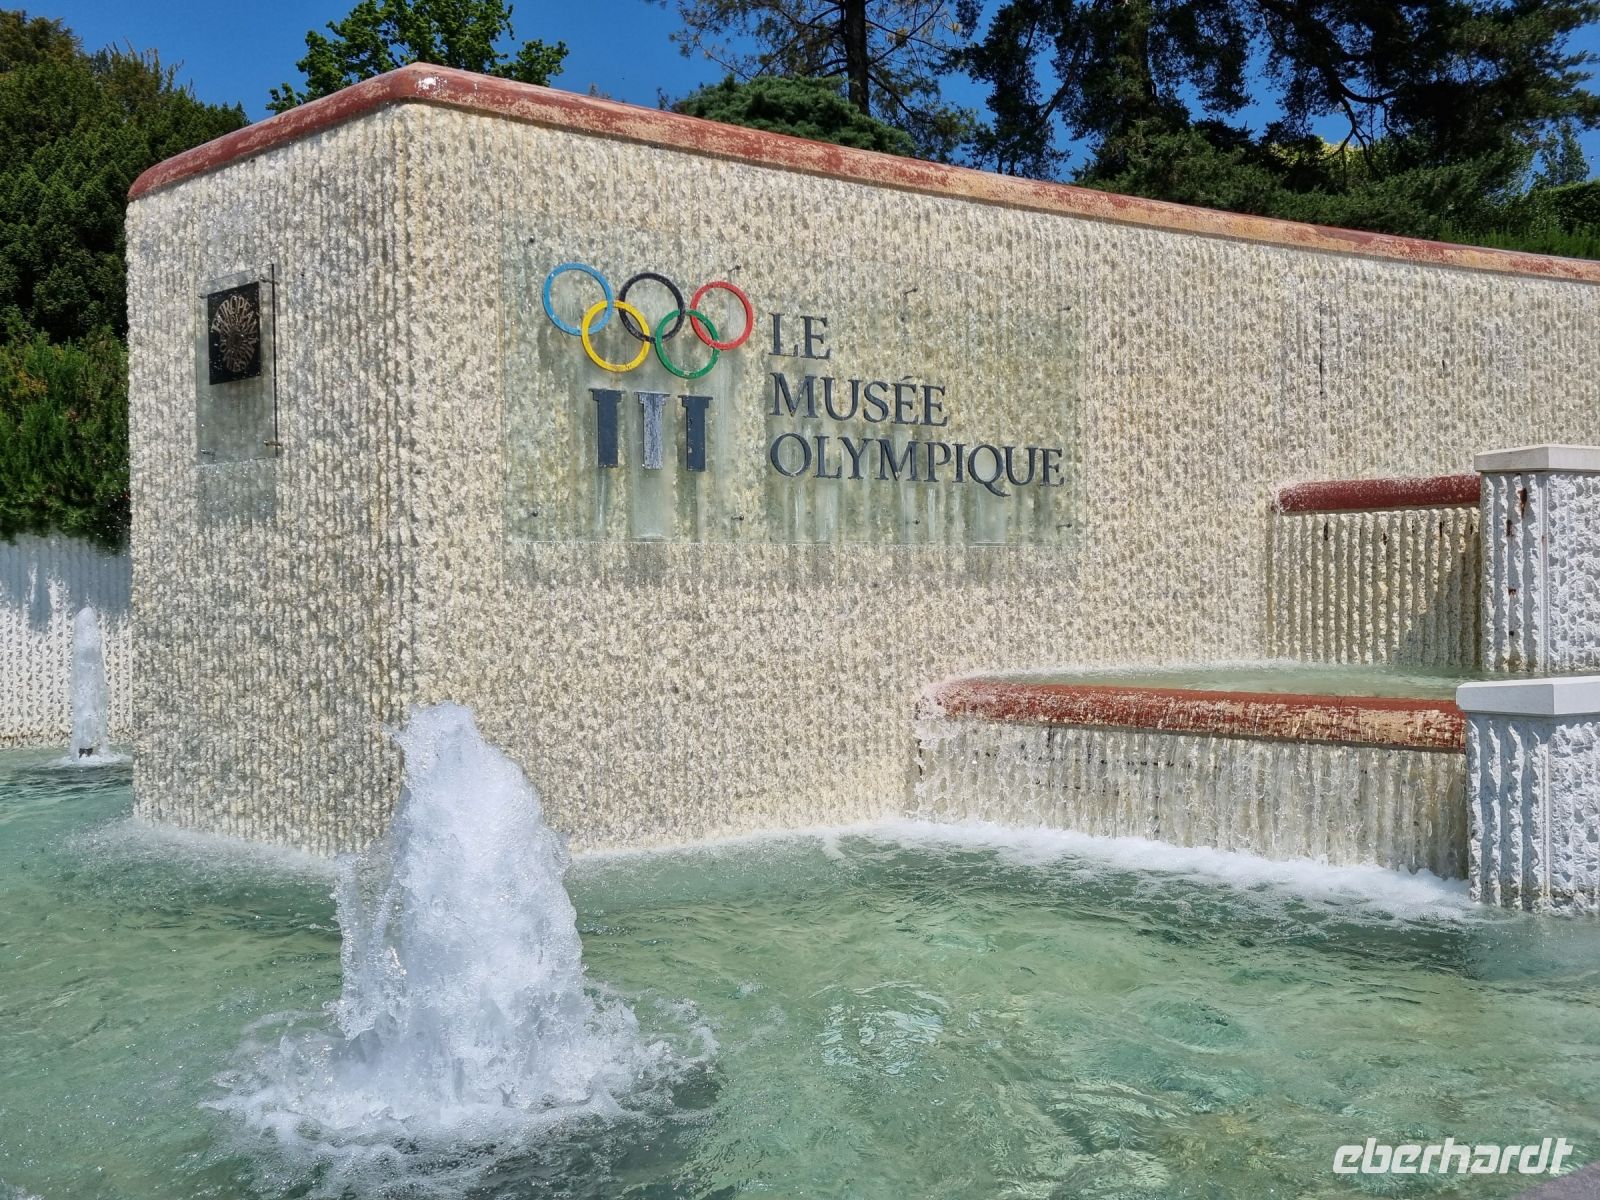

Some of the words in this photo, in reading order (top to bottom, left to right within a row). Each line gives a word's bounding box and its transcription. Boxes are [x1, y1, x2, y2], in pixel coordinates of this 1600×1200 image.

[210, 295, 258, 334] EUROPEAN
[768, 312, 831, 360] LE
[769, 372, 949, 428] MUSÉE
[770, 432, 1065, 498] OLYMPIQUE
